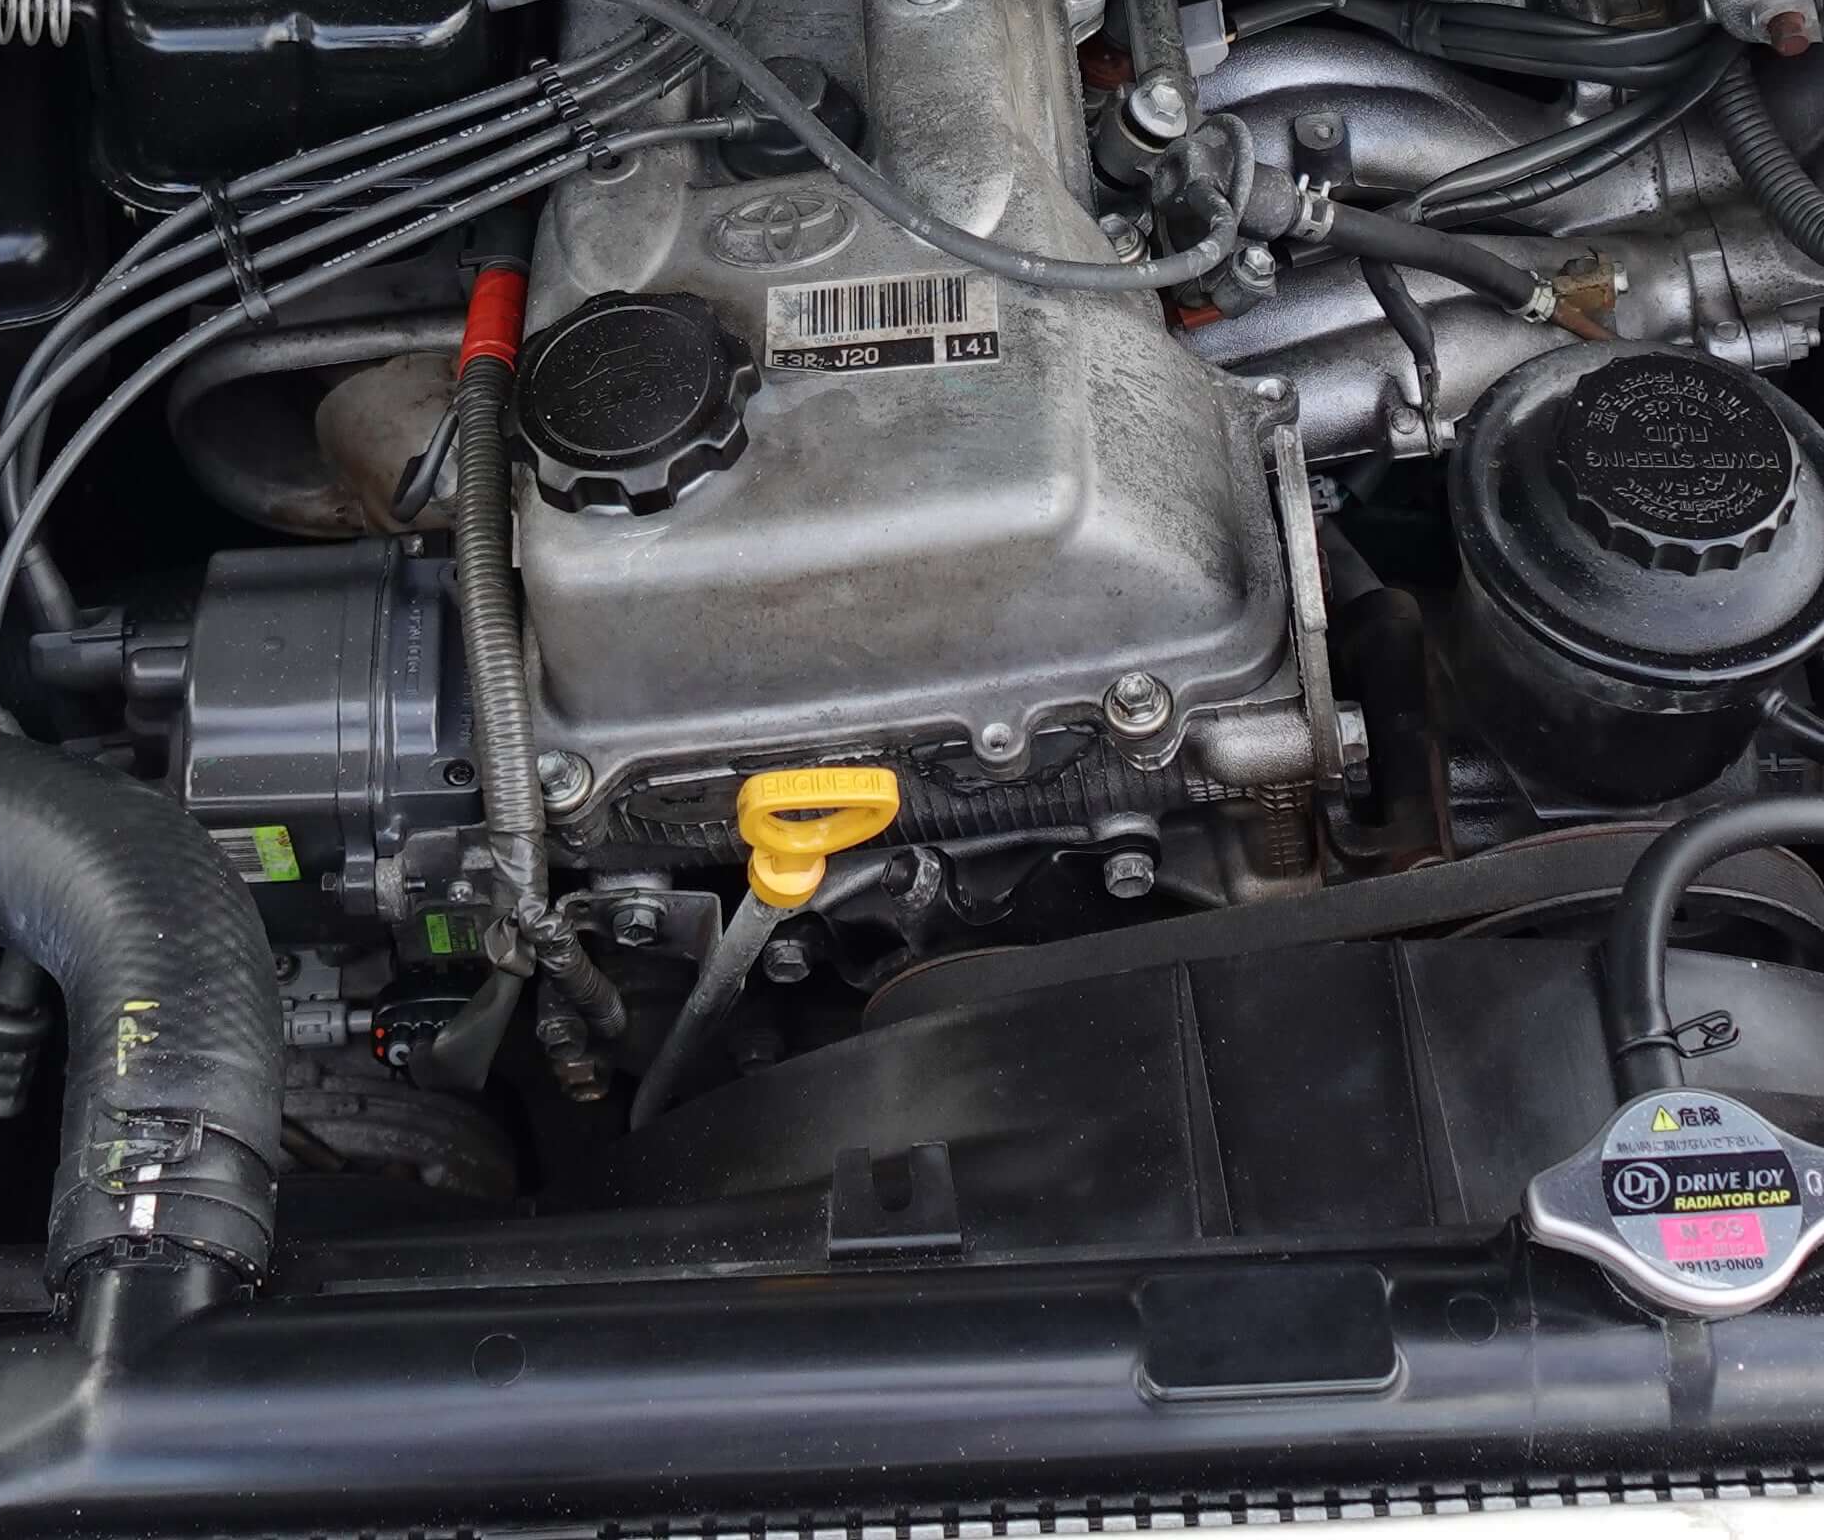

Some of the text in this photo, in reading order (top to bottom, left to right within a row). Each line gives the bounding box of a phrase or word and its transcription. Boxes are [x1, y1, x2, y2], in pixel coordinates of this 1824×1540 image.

[951, 337, 994, 357] 141
[1646, 426, 1709, 442] FLUID
[1586, 451, 1781, 469] POWER STEERING
[761, 773, 850, 797] ENGINE
[1679, 1106, 1722, 1128] 危険
[1624, 1170, 1657, 1204] DJ
[1677, 1168, 1785, 1193] DRIVE JOY
[1675, 1190, 1791, 1211] RADIATOR CAP
